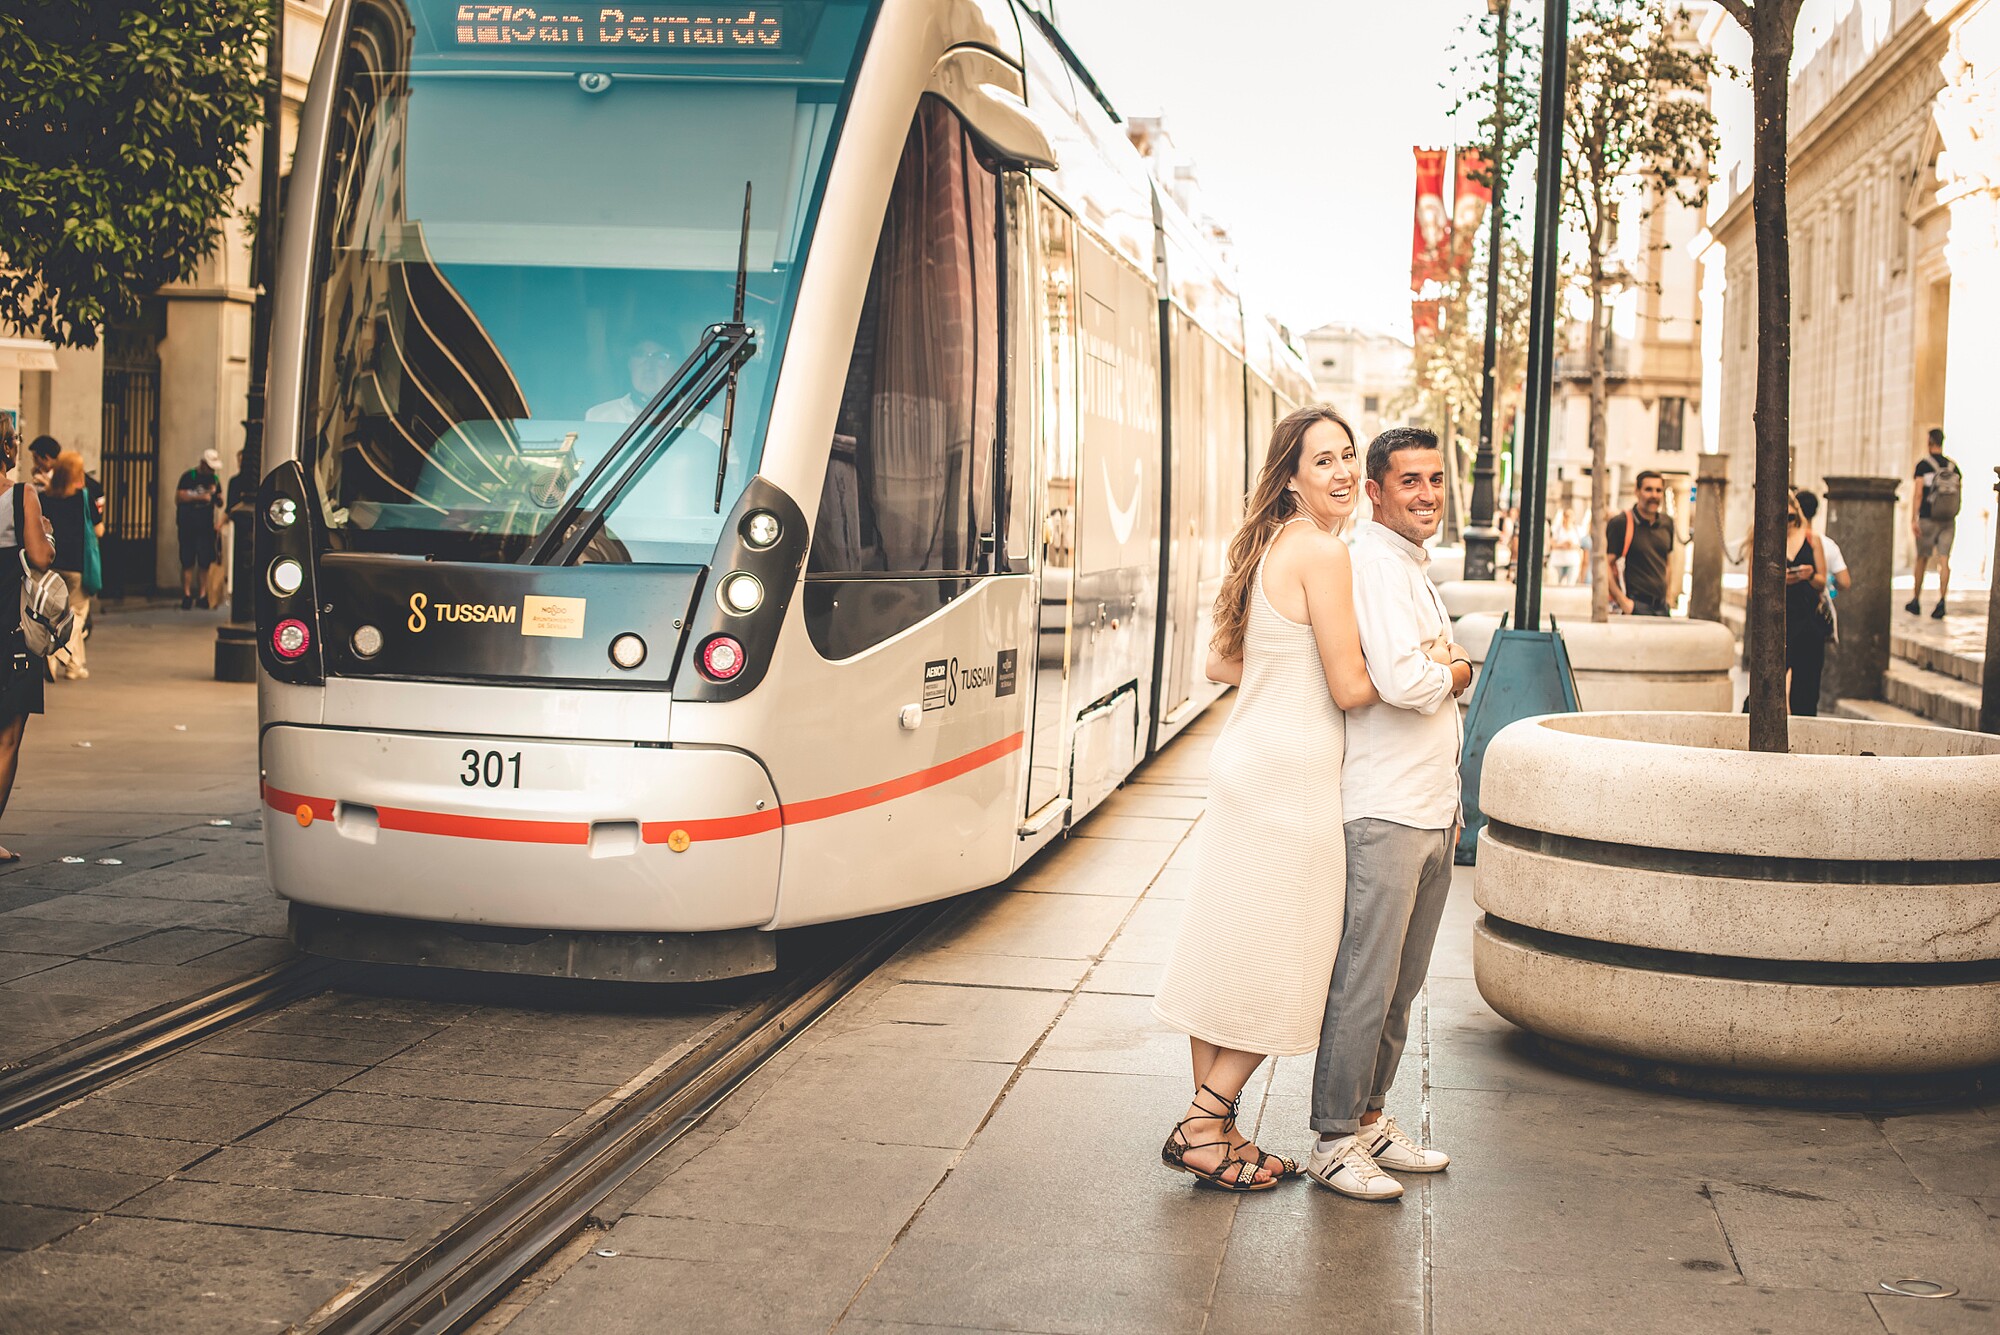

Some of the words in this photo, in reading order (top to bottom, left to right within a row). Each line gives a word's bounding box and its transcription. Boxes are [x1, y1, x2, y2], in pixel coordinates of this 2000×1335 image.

[434, 603, 517, 624] TUSSAM
[926, 665, 946, 678] AENOR
[961, 665, 995, 690] TUSSAM
[460, 749, 521, 788] 301
